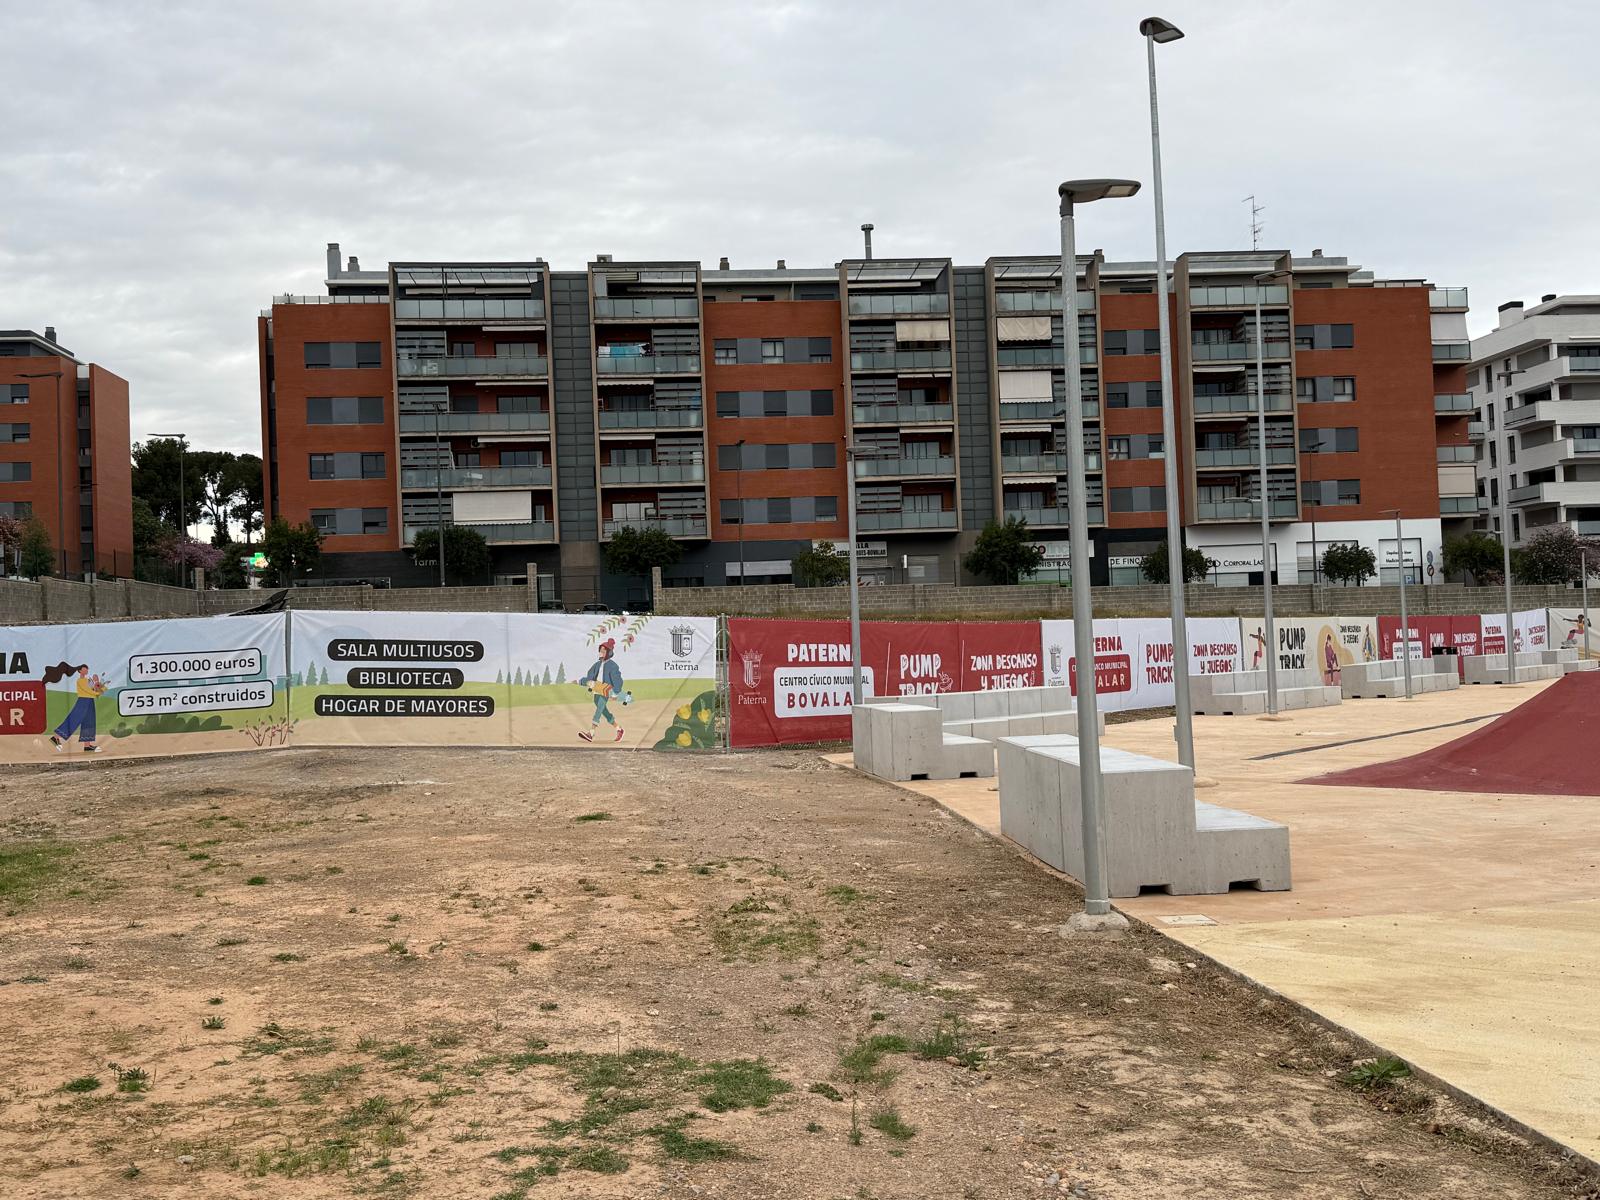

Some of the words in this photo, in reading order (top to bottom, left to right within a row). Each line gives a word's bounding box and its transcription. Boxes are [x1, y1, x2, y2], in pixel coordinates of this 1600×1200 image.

[1093, 636, 1122, 652] ERNA
[1280, 627, 1306, 651] PUMP
[337, 643, 378, 657] SALA
[383, 644, 475, 658] MULTIUSOS
[787, 643, 854, 662] PATERN
[1146, 643, 1173, 664] PUMP
[1193, 644, 1208, 657] ZONA
[1210, 643, 1237, 656] DESCANSO
[136, 659, 211, 675] 1.300.000
[215, 657, 255, 670] euros
[664, 662, 699, 671] Paterna
[900, 653, 941, 679] PUMP
[970, 654, 994, 671] ZONA
[996, 653, 1038, 670] DESCANSO
[1207, 659, 1232, 673] JUEGOS
[1280, 654, 1305, 669] TRACK
[359, 671, 452, 686] BIBLIOTECA
[779, 676, 808, 686] CENTRO
[809, 673, 832, 685] CÍVICO
[991, 672, 1029, 689] JUEGOS
[1146, 666, 1173, 684] TRACK
[127, 695, 154, 708] 753
[181, 688, 266, 705] construidos
[322, 699, 380, 713] HOGAR
[385, 700, 406, 713] DE
[411, 700, 488, 713] MAYORES
[738, 695, 767, 705] Paterna
